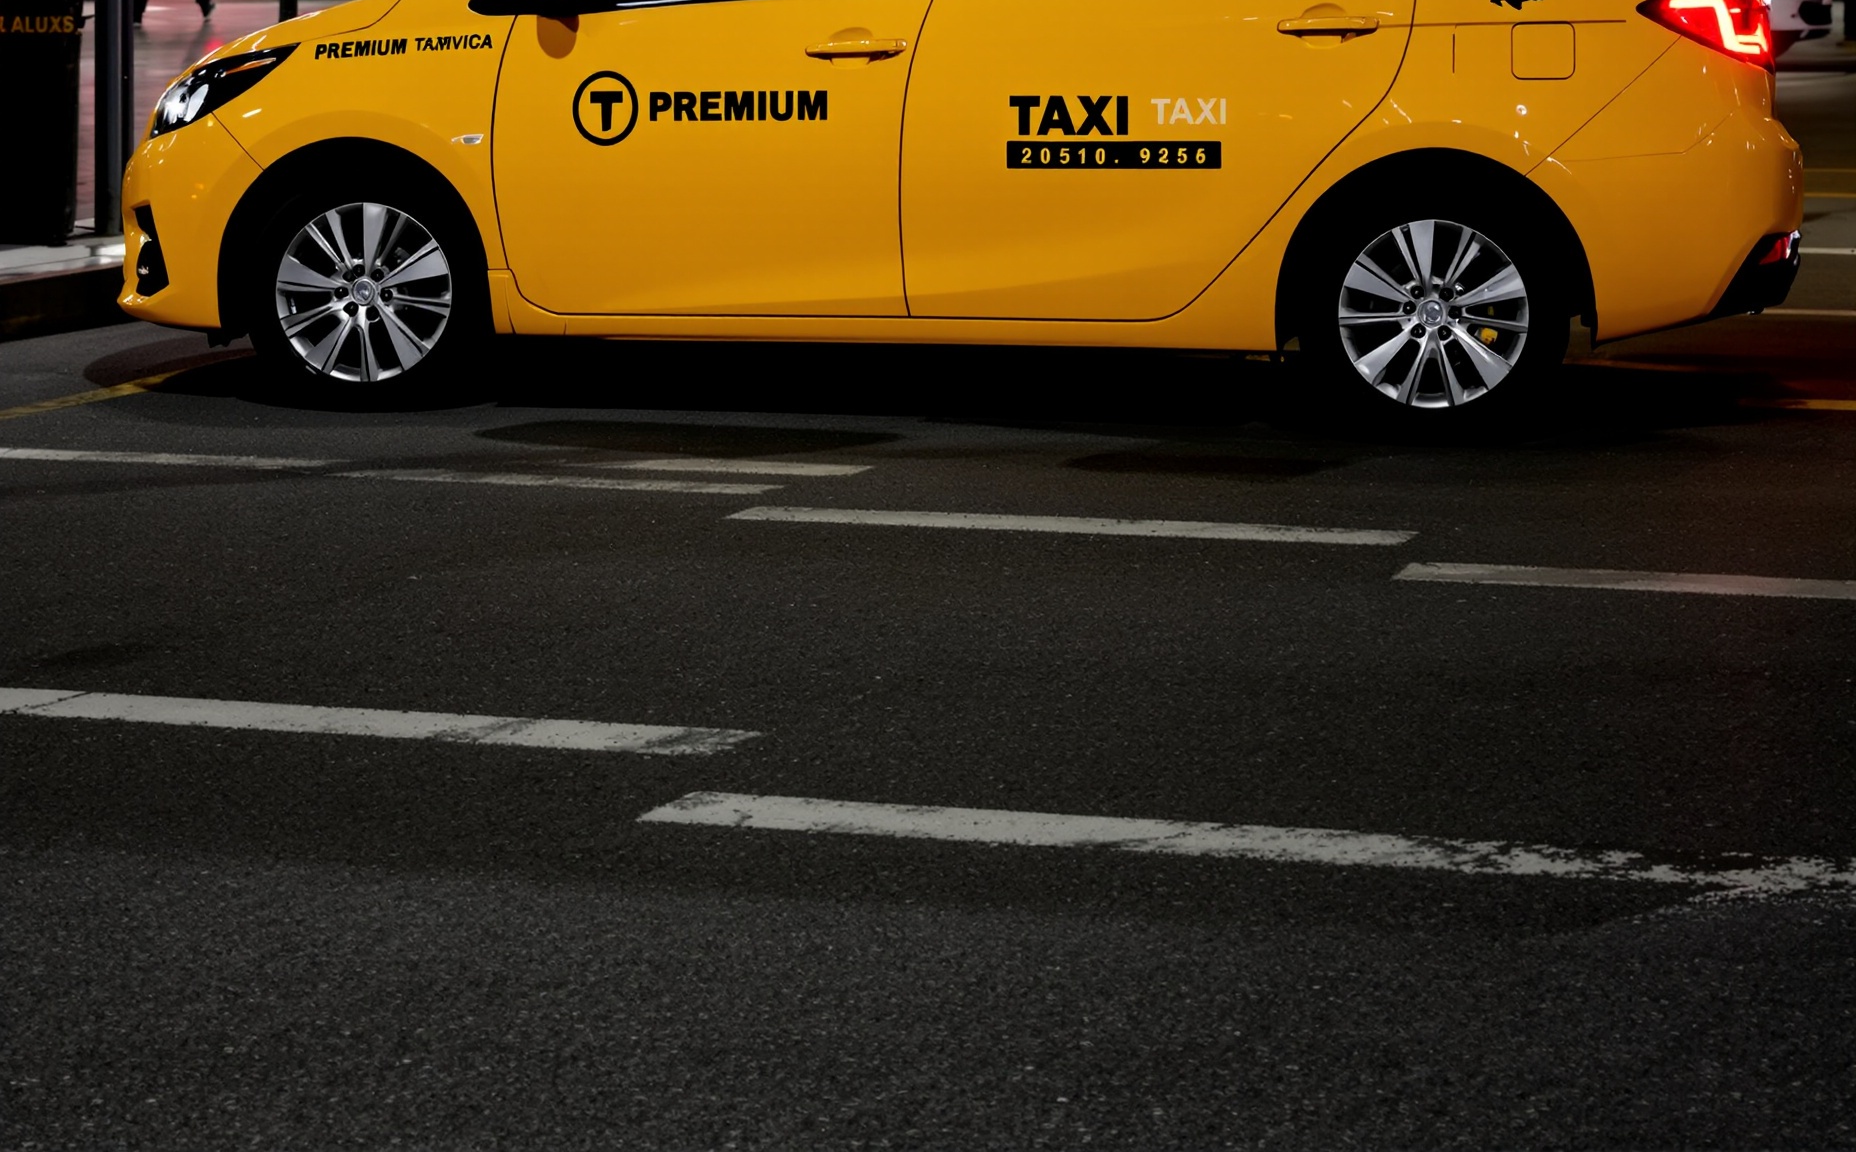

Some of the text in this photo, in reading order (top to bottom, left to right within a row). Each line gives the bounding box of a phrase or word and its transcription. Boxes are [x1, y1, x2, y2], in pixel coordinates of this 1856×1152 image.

[314, 38, 408, 60] PREMIUM
[649, 90, 828, 122] PREMIUM
[1009, 95, 1227, 136] TAXI TAXI
